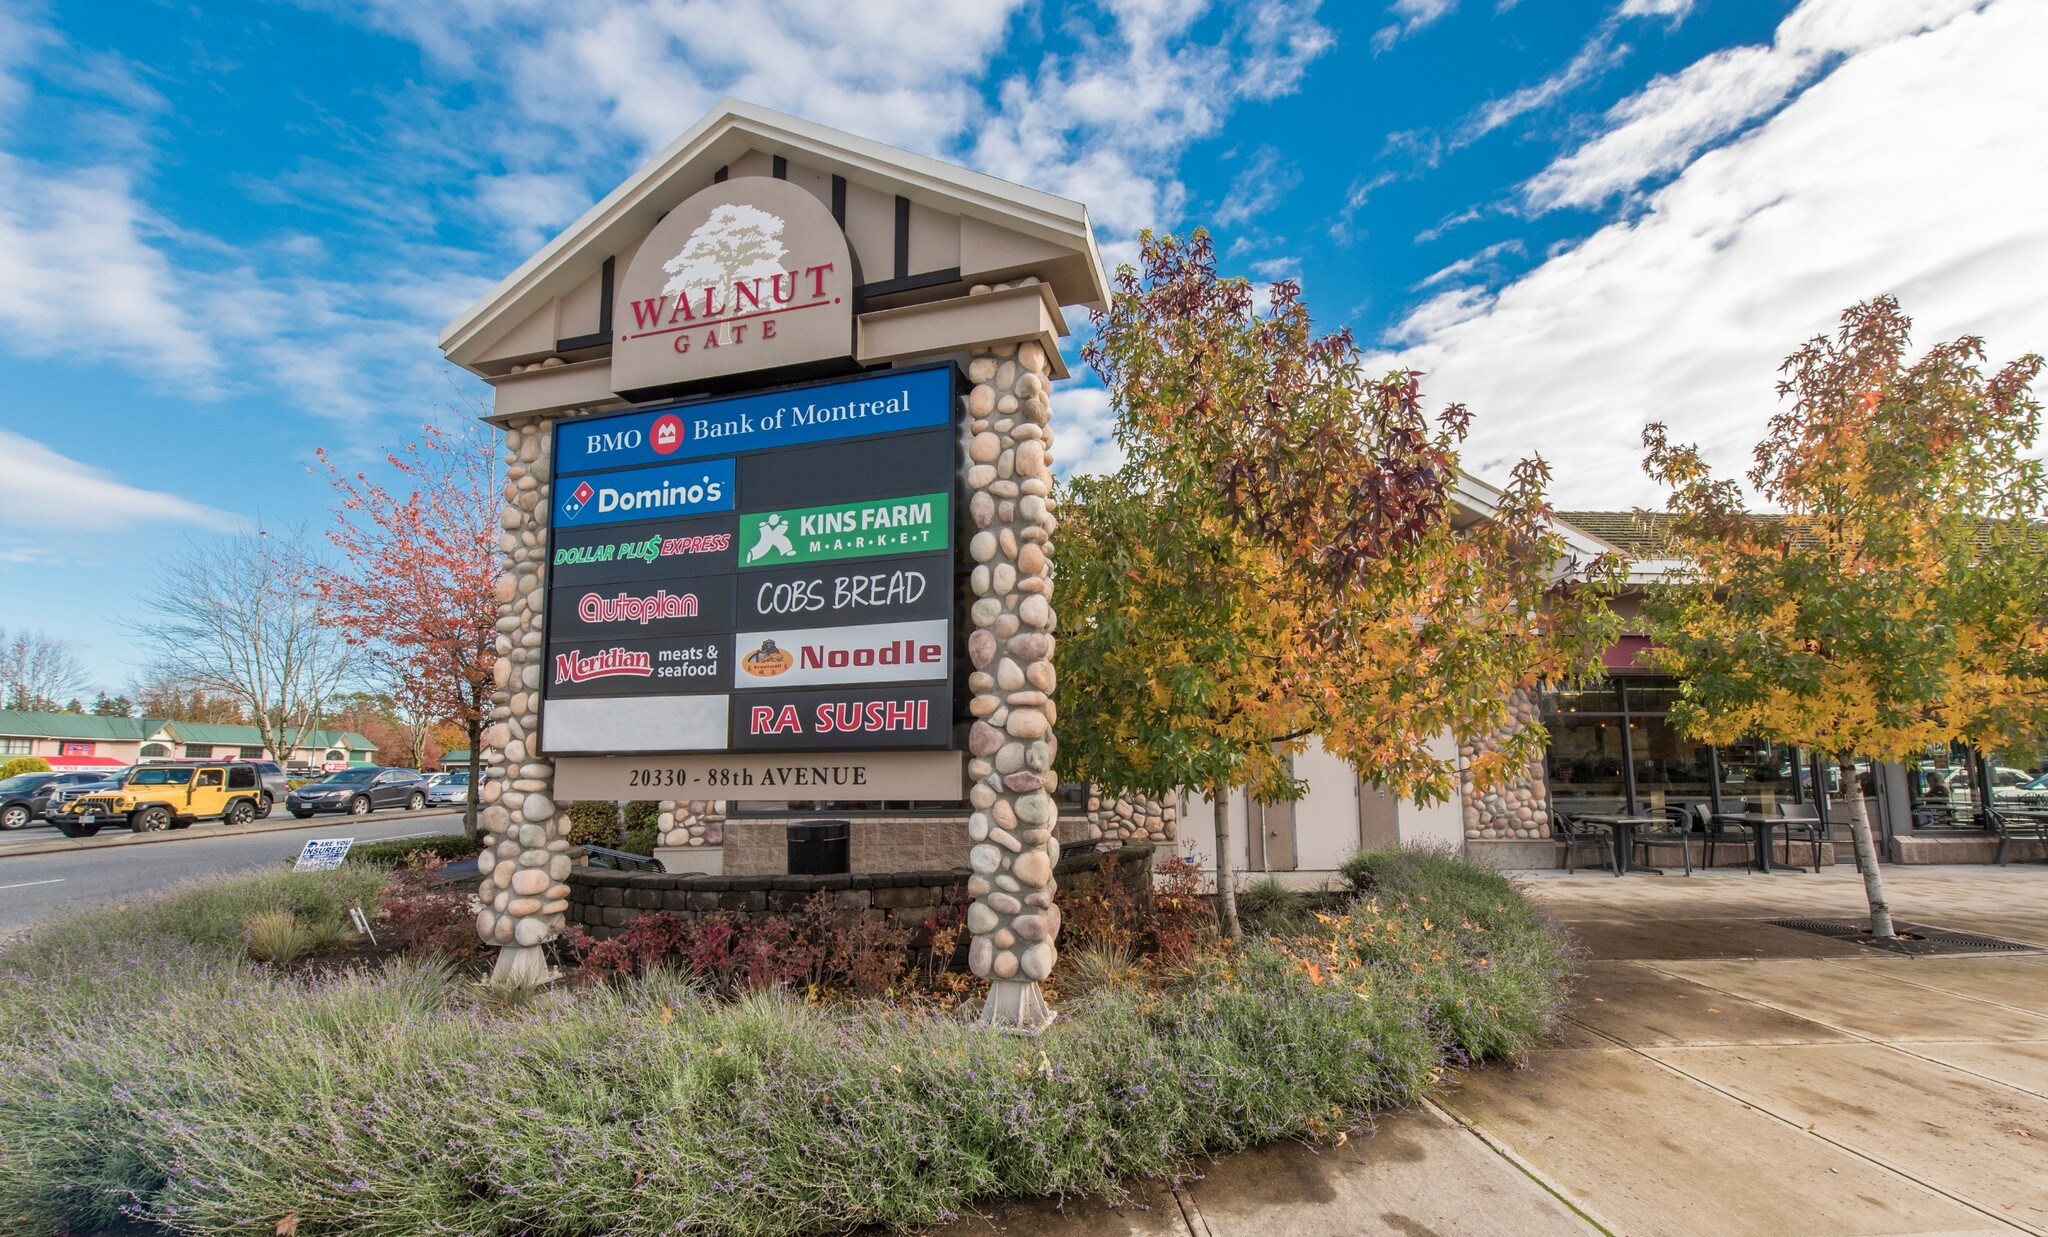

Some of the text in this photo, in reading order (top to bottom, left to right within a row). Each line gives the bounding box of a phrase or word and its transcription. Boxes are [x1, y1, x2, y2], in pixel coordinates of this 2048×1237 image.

[631, 262, 834, 331] WALNUT
[674, 319, 776, 354] GATE
[586, 390, 911, 455] BMO Bank of Montreal
[598, 476, 722, 513] Domino's
[800, 502, 932, 537] KINS FARM
[553, 544, 615, 566] DOLLAR
[660, 533, 731, 557] EXPRESS
[756, 570, 927, 615] COBS BREAD
[555, 644, 719, 686] Meridian meats &
[657, 661, 718, 678] seafood
[799, 640, 943, 671] Noodle
[750, 698, 929, 735] RA SUSHI
[629, 768, 687, 788] 20330
[707, 767, 753, 787] 88th
[760, 765, 867, 787] AVENUE
[303, 846, 347, 854] INSURED?
